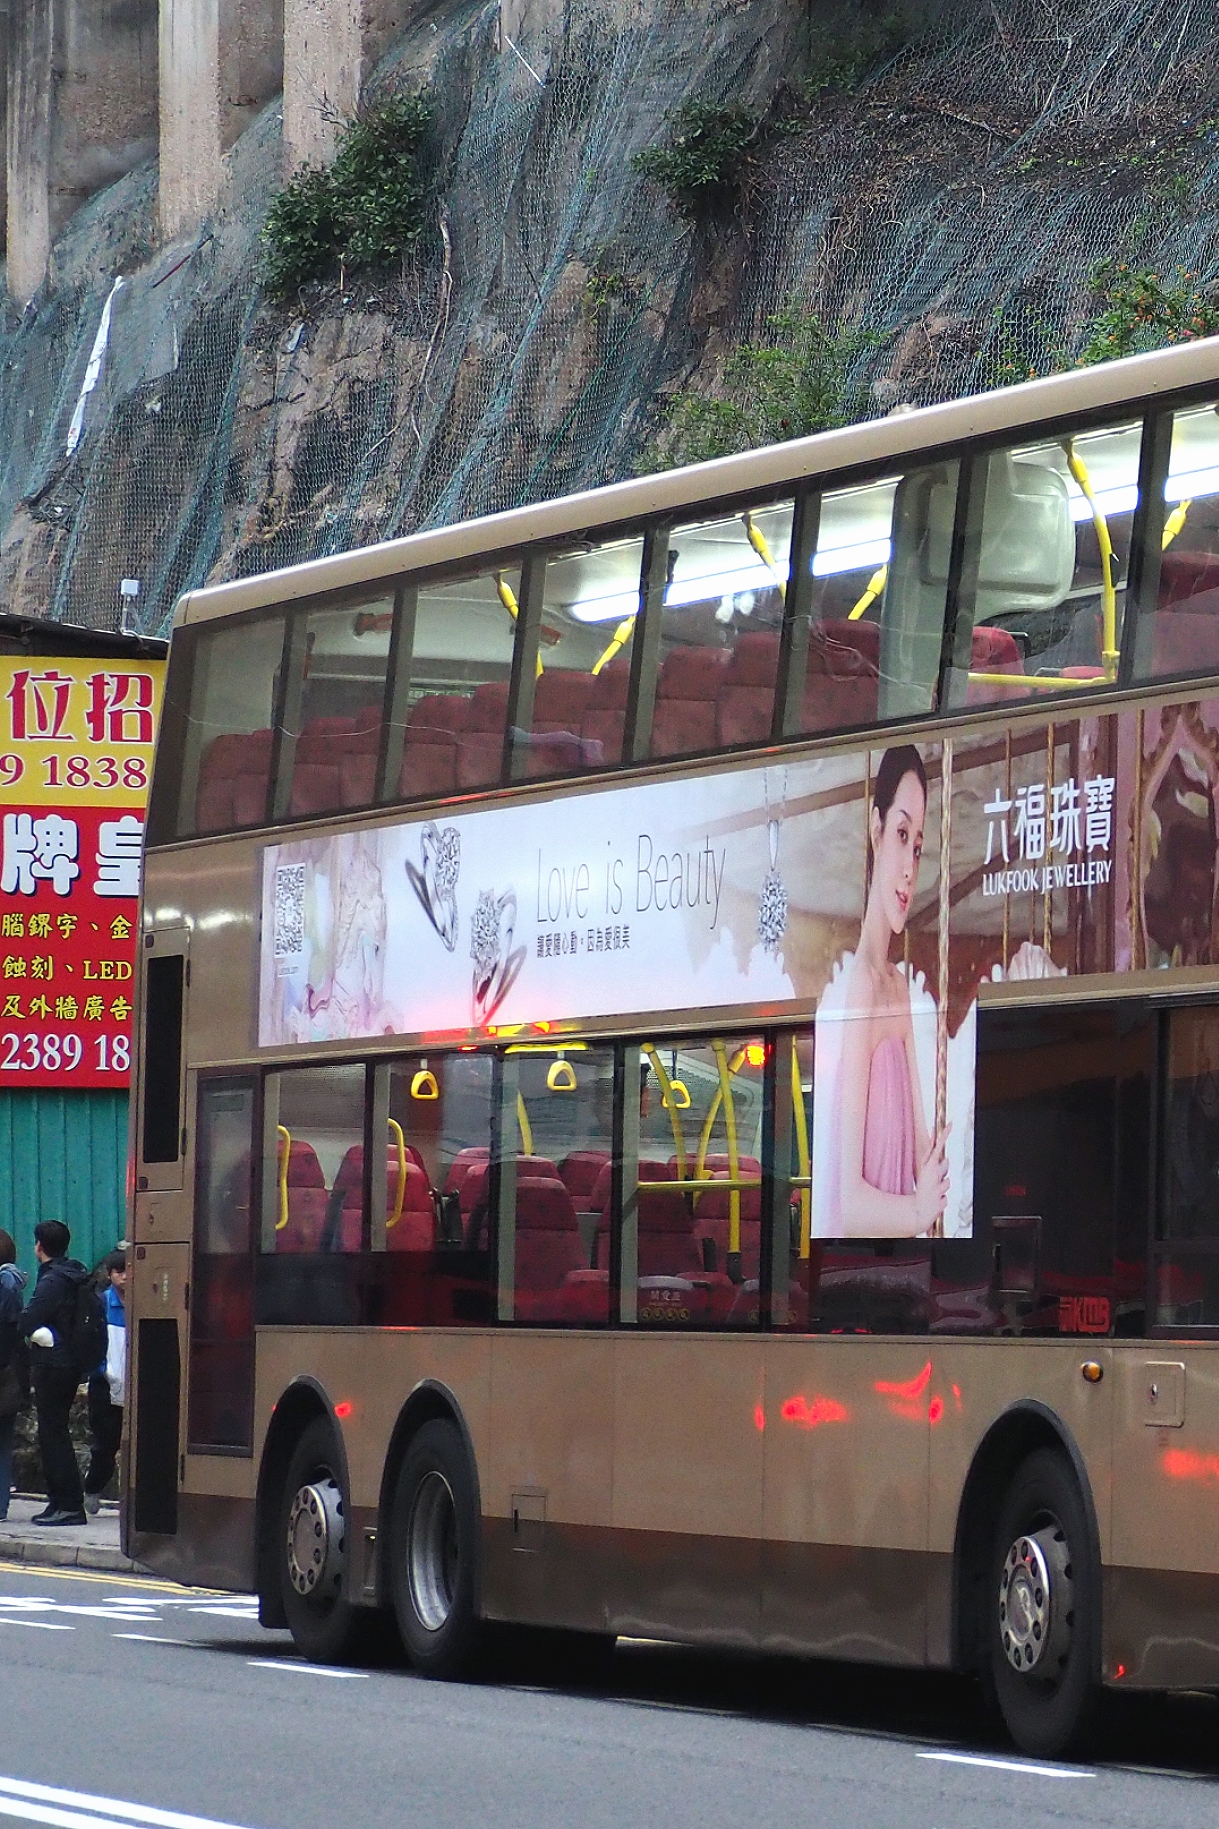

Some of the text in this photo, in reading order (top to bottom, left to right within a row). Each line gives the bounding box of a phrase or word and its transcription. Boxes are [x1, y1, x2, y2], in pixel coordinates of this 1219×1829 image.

[7, 670, 155, 744] 位招
[41, 755, 147, 789] 1838
[983, 774, 1116, 865] 六福珠寶
[537, 833, 727, 930] Love is Beauty
[983, 860, 1113, 896] LUKFOOK JEWELLERY
[0, 1033, 131, 1072] 2389 18
